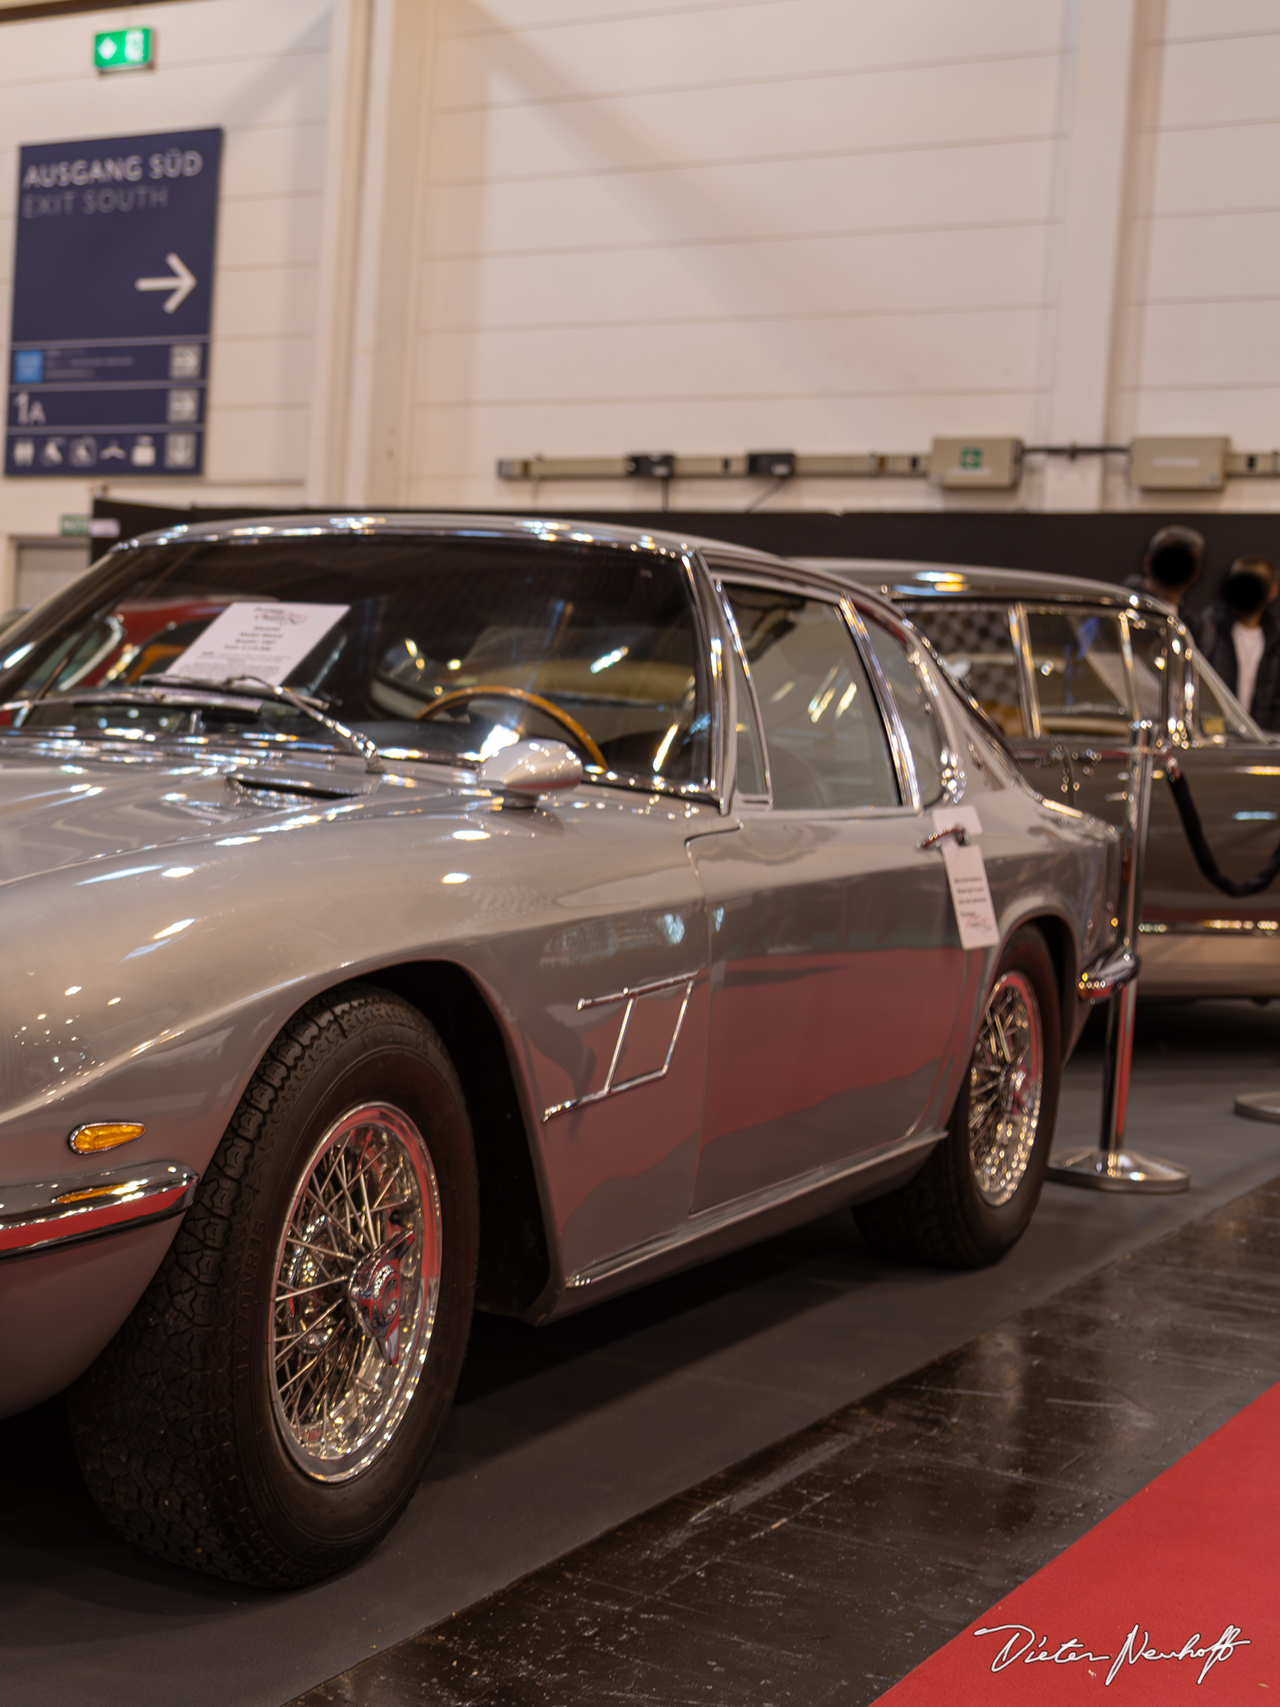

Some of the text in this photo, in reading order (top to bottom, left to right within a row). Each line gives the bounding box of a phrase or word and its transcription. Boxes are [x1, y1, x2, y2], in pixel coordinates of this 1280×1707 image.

[22, 148, 204, 189] AUSGANG SÜD
[22, 184, 169, 219] EXIT SOUTH
